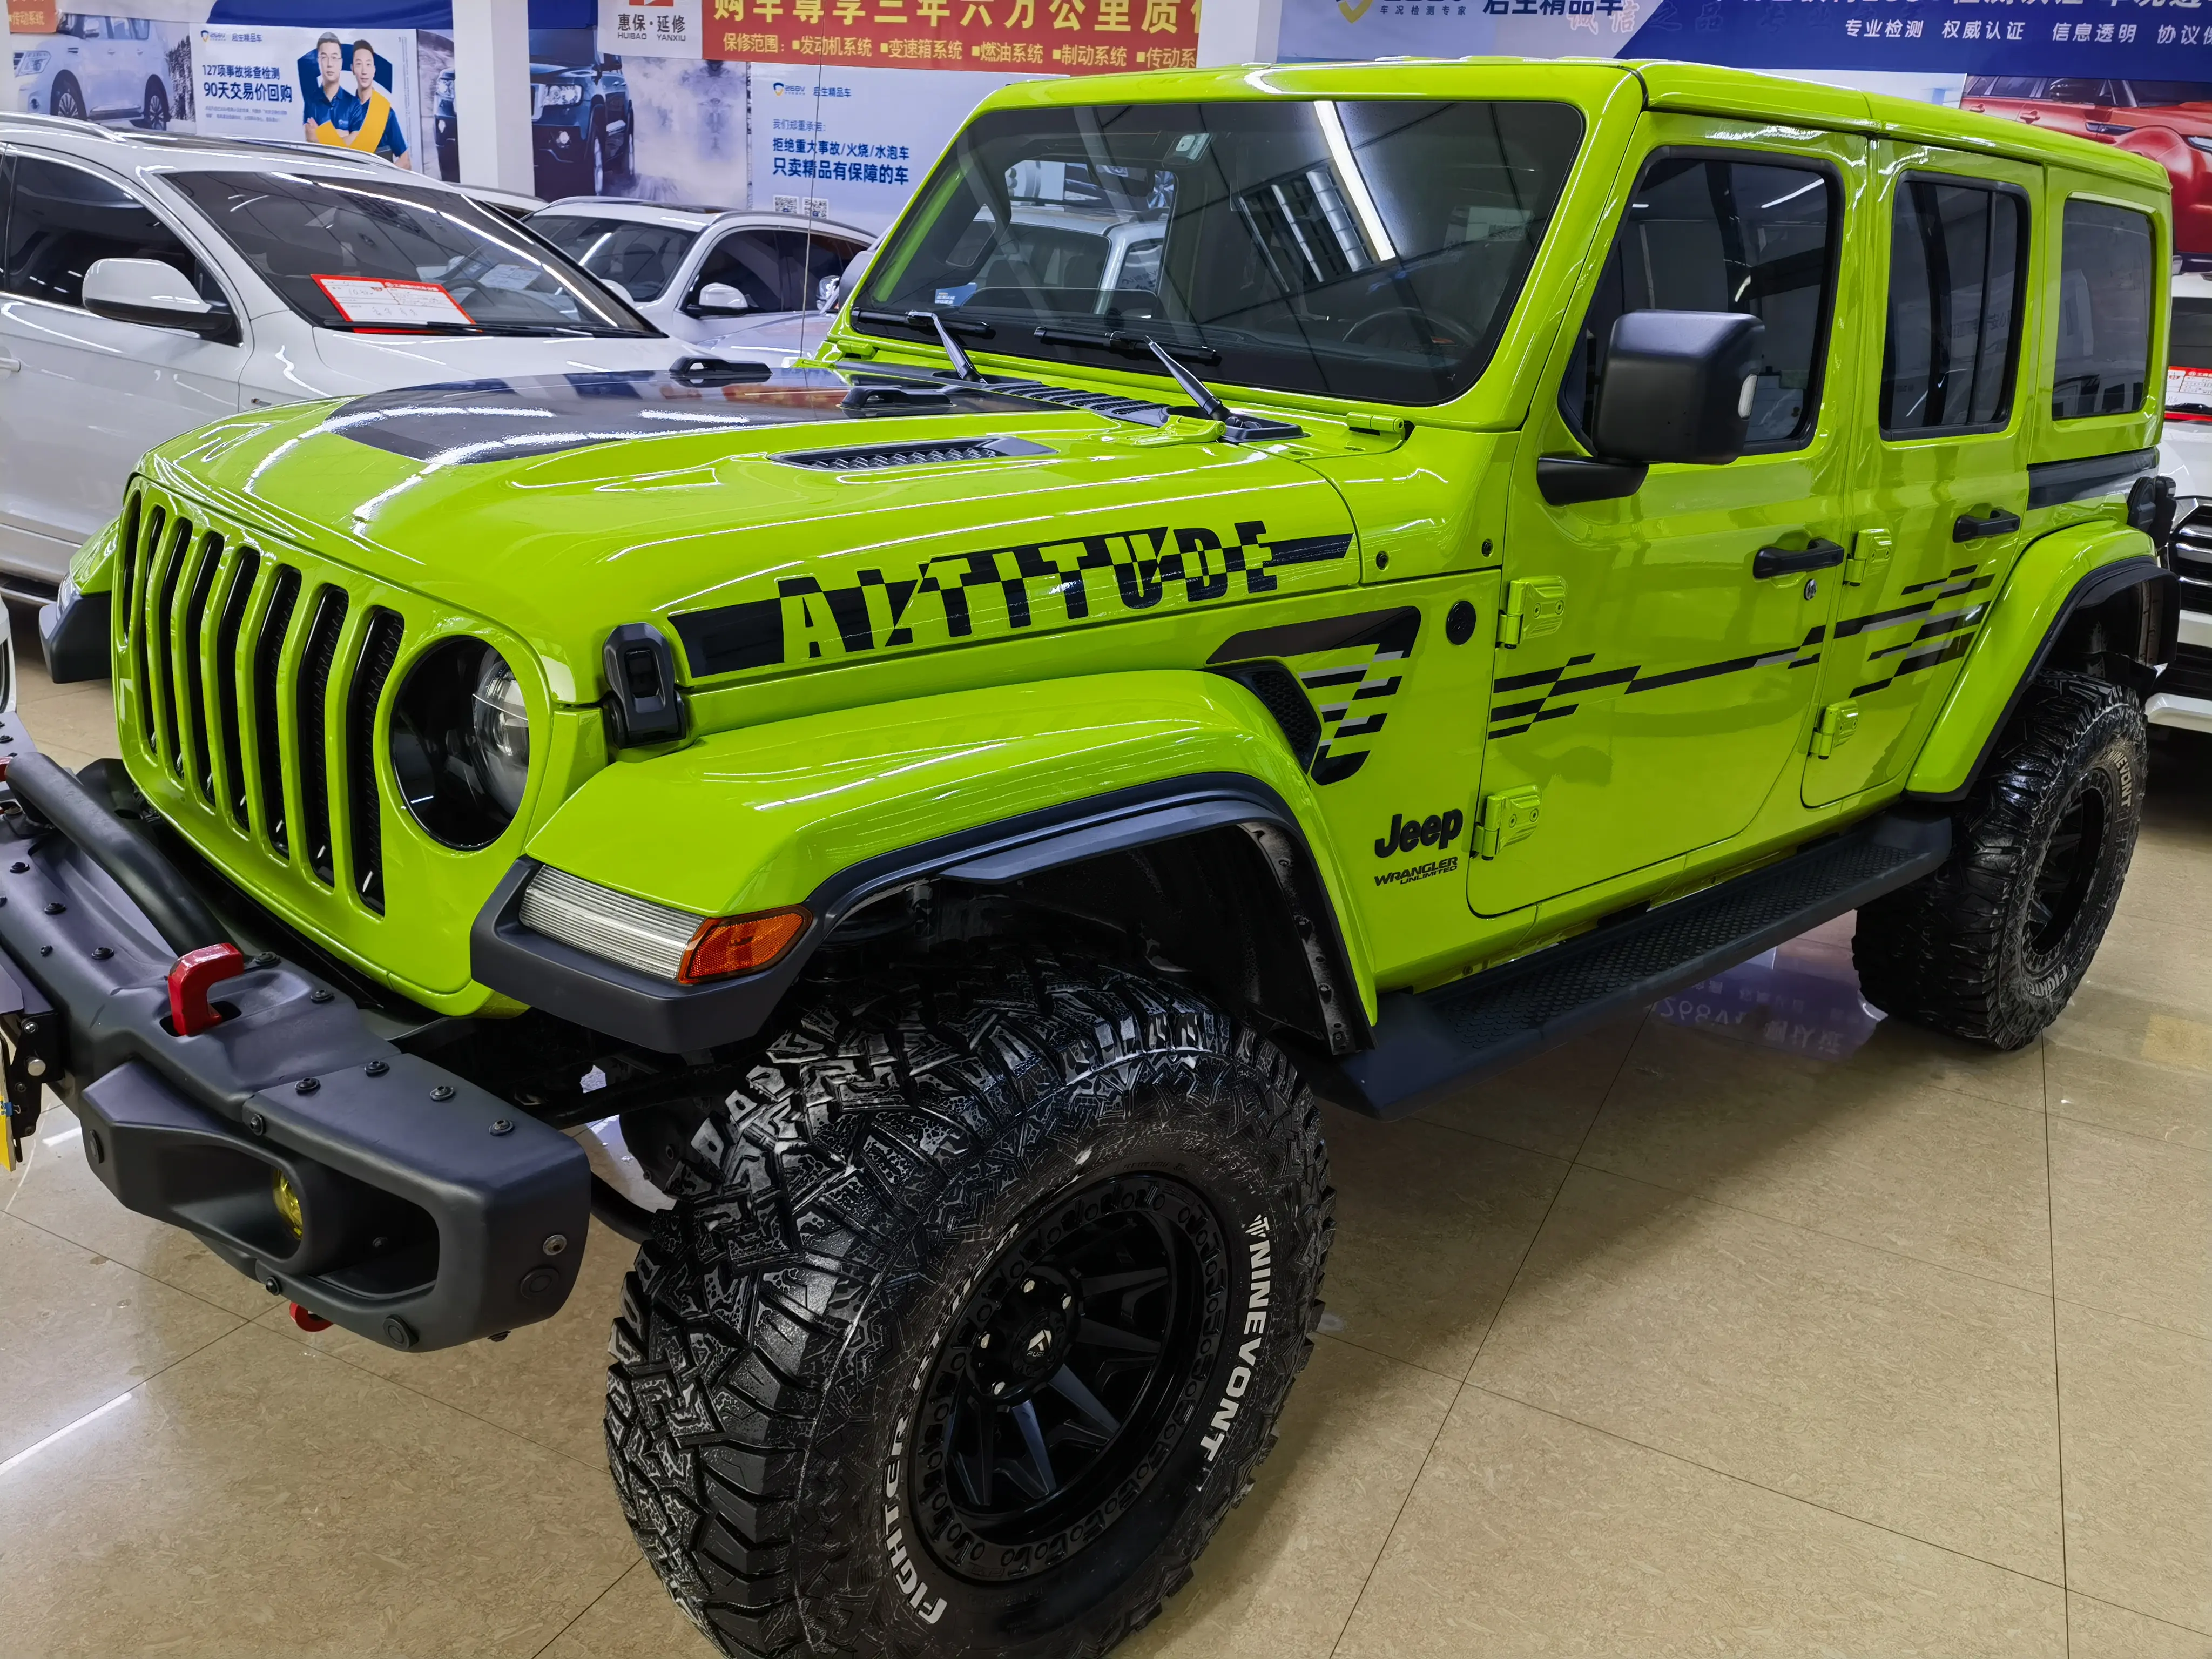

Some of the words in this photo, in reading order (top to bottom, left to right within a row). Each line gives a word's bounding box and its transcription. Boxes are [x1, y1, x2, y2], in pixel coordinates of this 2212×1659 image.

[618, 13, 685, 33] 惠保·延修
[713, 0, 1199, 35] 购车尊享三年六万公里质
[1380, 5, 1466, 16] 车况检测专家
[617, 32, 647, 40] HUIBAO
[656, 33, 686, 42] YANXIU
[1845, 19, 1924, 38] 专业检测
[1941, 20, 2026, 41] 权威认证
[2052, 22, 2137, 43] 信息透明
[800, 36, 872, 57] 发动机系统
[888, 39, 962, 60] 变速箱系统
[980, 41, 1043, 64] 燃油系统
[1062, 44, 1127, 68] 制动系统
[202, 64, 280, 80] 127项事故排查检测
[204, 82, 292, 103] 90天交易价回购
[772, 137, 909, 160] 拒绝重大事故/火烧/水泡车
[773, 157, 909, 185] 只卖精品有保障的车
[775, 520, 1279, 664] ALTITUDE
[1374, 808, 1464, 858] Jeep
[1374, 856, 1458, 886] WRANGLER
[1400, 865, 1458, 885] UNLIMITED
[1199, 1239, 1271, 1462] NINEVONT
[884, 1413, 948, 1624] FIGHTER
